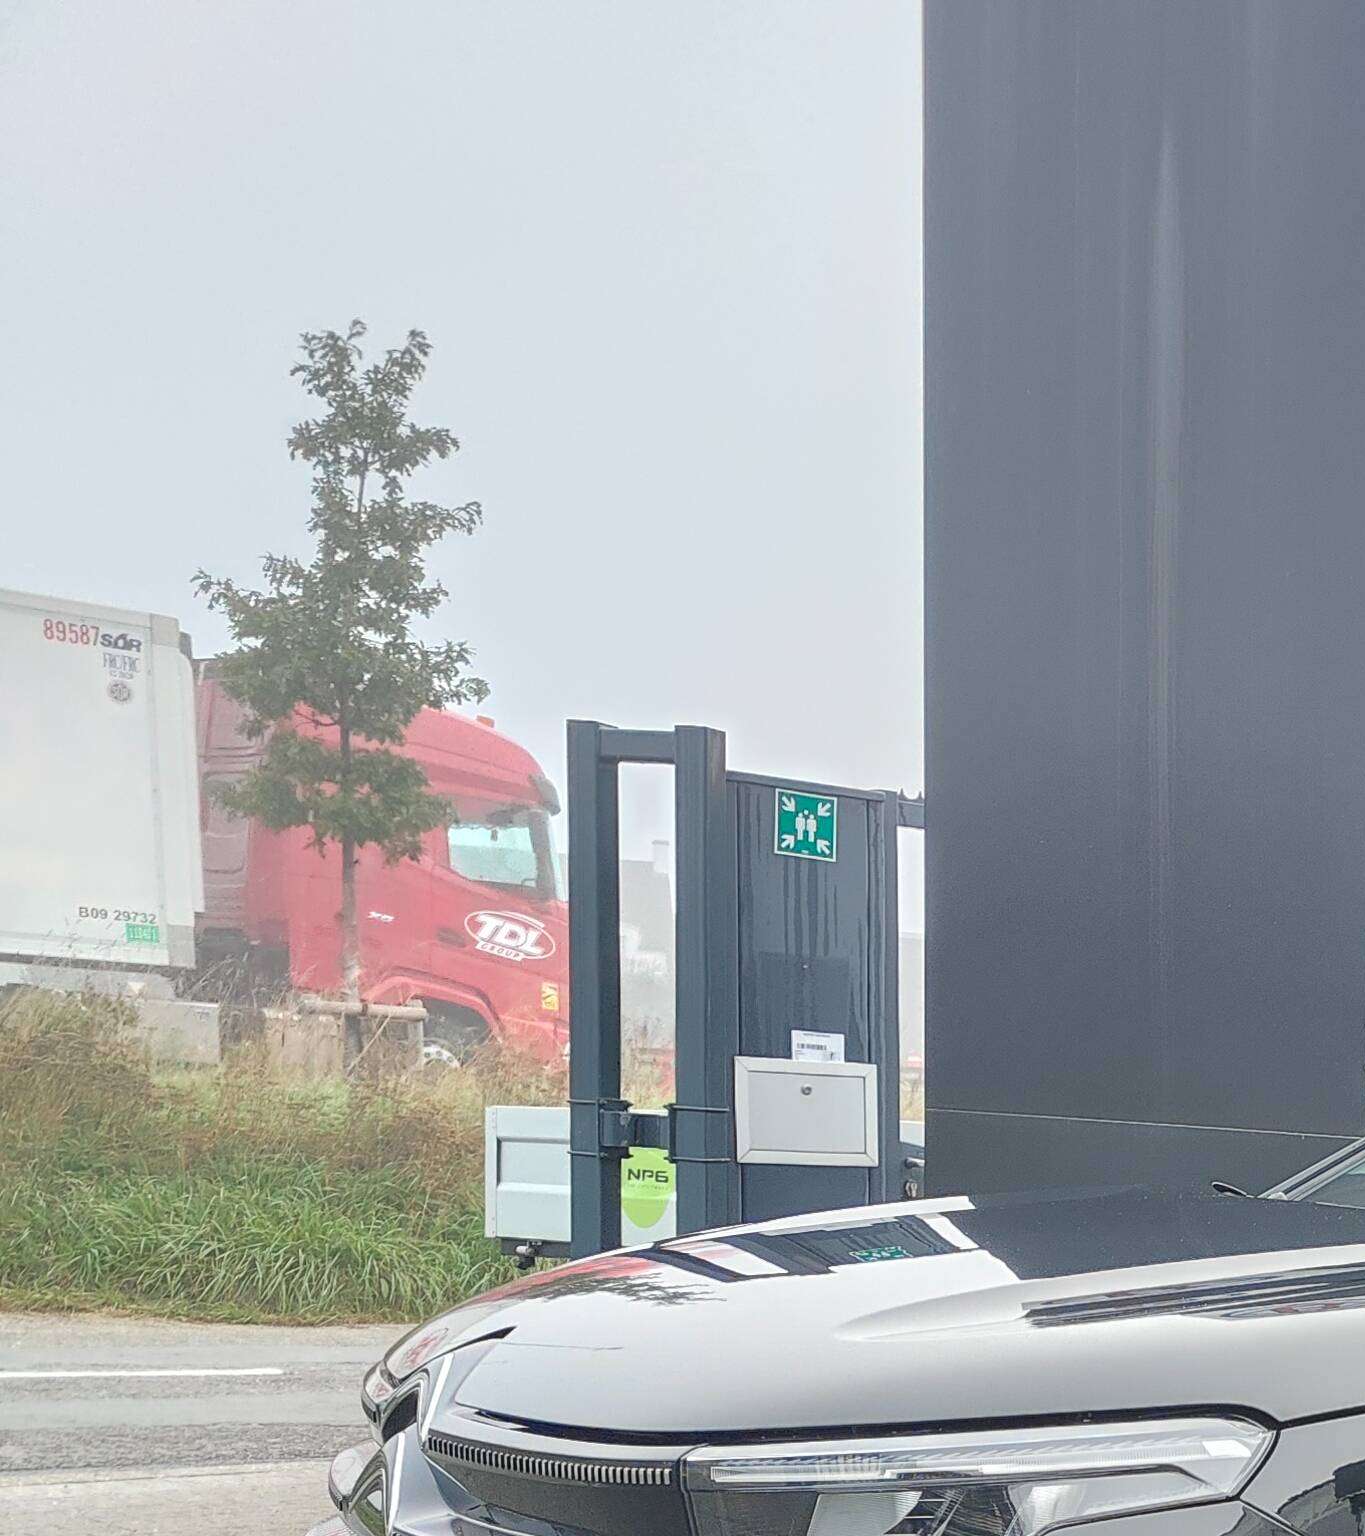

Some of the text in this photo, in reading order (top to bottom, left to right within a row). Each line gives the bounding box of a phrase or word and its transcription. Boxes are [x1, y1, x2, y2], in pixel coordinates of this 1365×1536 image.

[43, 618, 100, 647] 89587
[475, 913, 546, 956] TDL
[480, 942, 522, 960] GROUP
